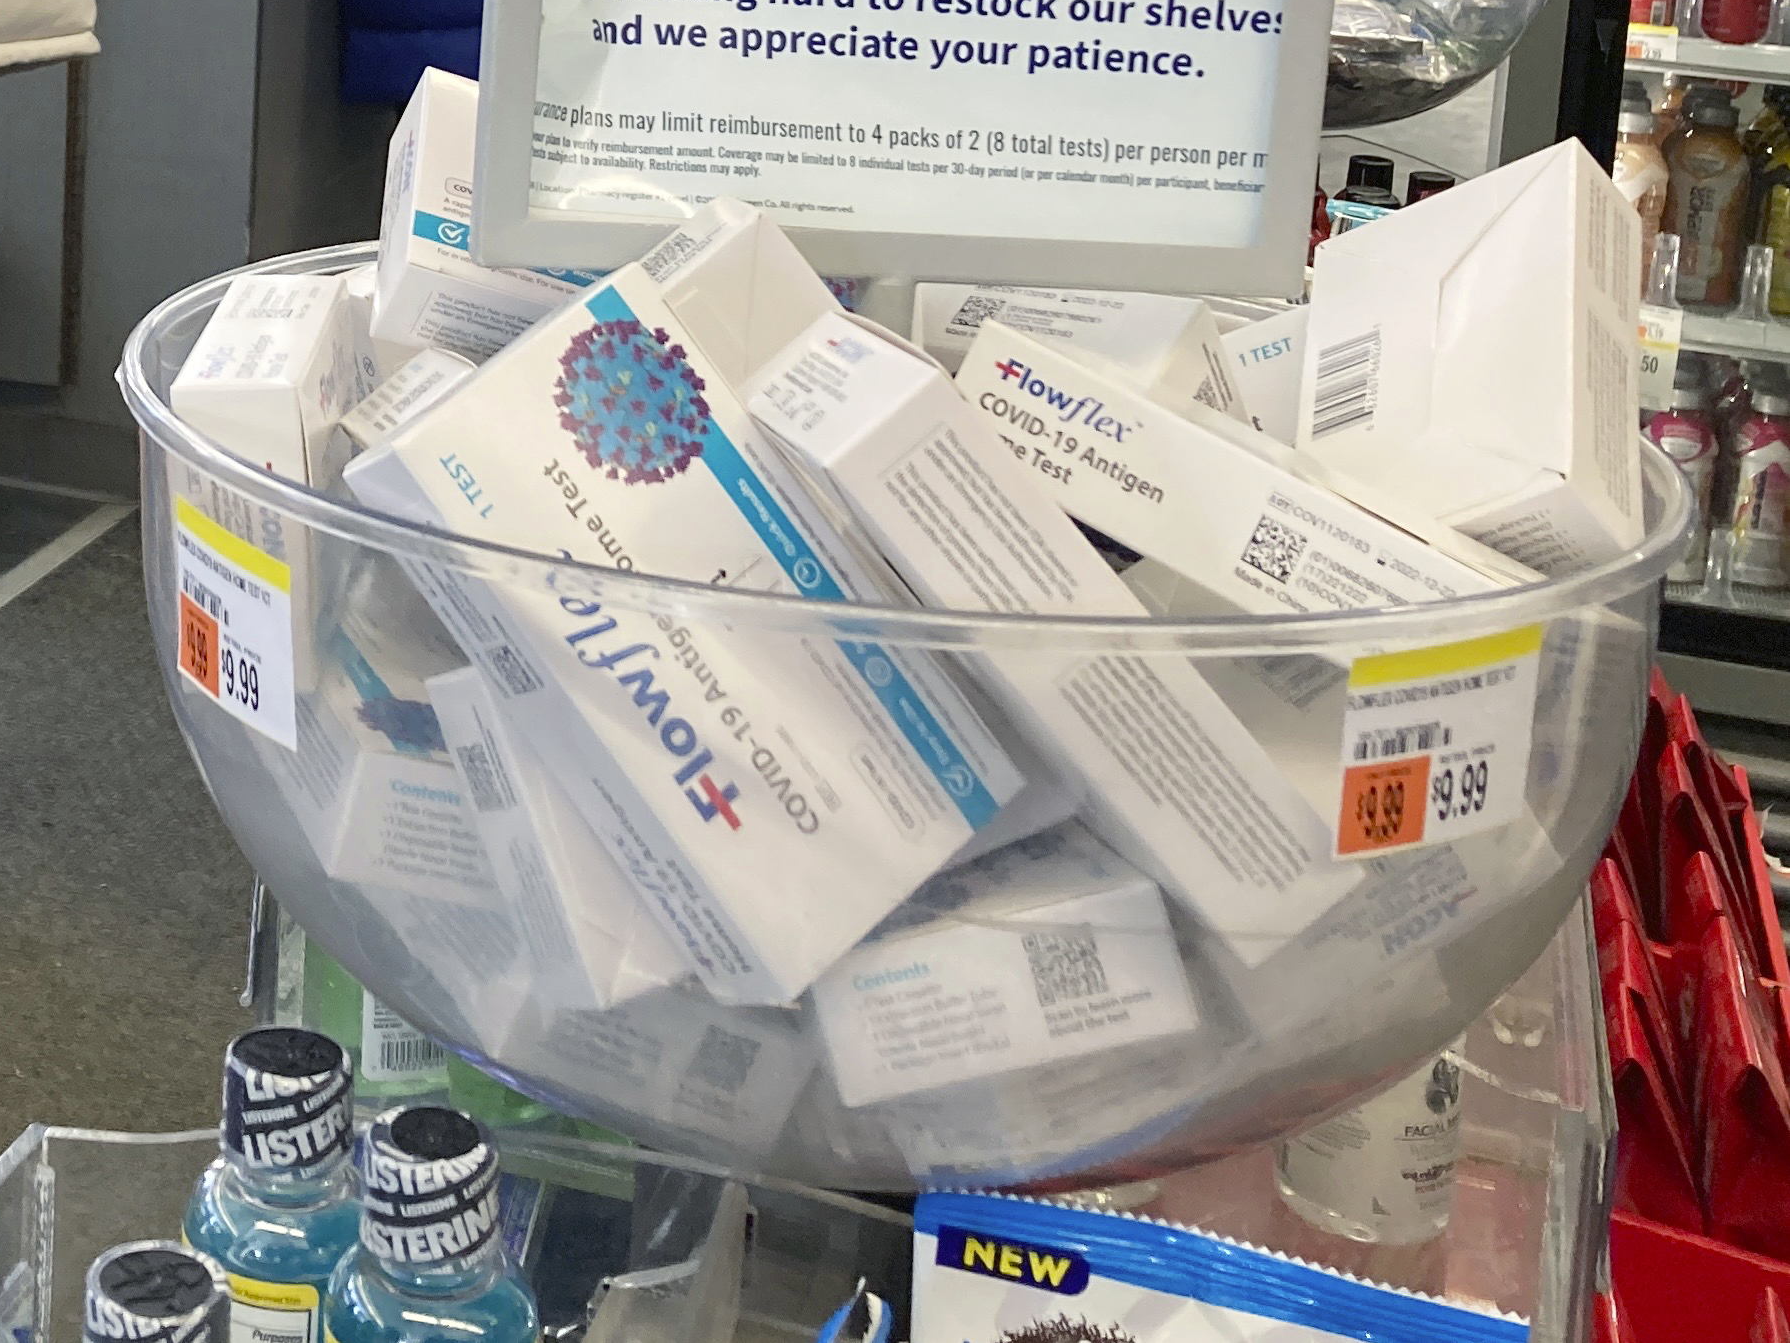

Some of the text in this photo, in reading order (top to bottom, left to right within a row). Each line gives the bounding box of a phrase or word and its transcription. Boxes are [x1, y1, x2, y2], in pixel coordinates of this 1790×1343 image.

[592, 14, 1205, 78] and we appreciate your patience.
[570, 104, 614, 129] plans
[619, 113, 656, 134] may
[662, 110, 704, 133] limit
[709, 114, 843, 144] reimbursement
[849, 123, 866, 145] to
[871, 123, 884, 145] 4
[889, 127, 940, 150] packs
[946, 129, 963, 150] of
[968, 130, 981, 151] 2
[987, 130, 1006, 157] (8
[1011, 133, 1053, 156] total
[1059, 135, 1110, 163] tests)
[1114, 142, 1144, 164] per
[1150, 145, 1212, 167] person
[1216, 149, 1248, 170] per
[1238, 336, 1294, 367] 1 TEST
[995, 357, 1134, 446] Flowflex
[439, 453, 481, 501] TEST
[979, 390, 1166, 506] COVID-19 Antigen
[1031, 450, 1075, 486] Test
[541, 457, 593, 519] Test
[221, 648, 259, 712] $9.99
[650, 608, 728, 705] Antige
[545, 549, 743, 831] Flowfle
[720, 705, 820, 836] COVID-19
[1431, 759, 1489, 822] $9.99
[962, 1235, 1073, 1288] NEW
